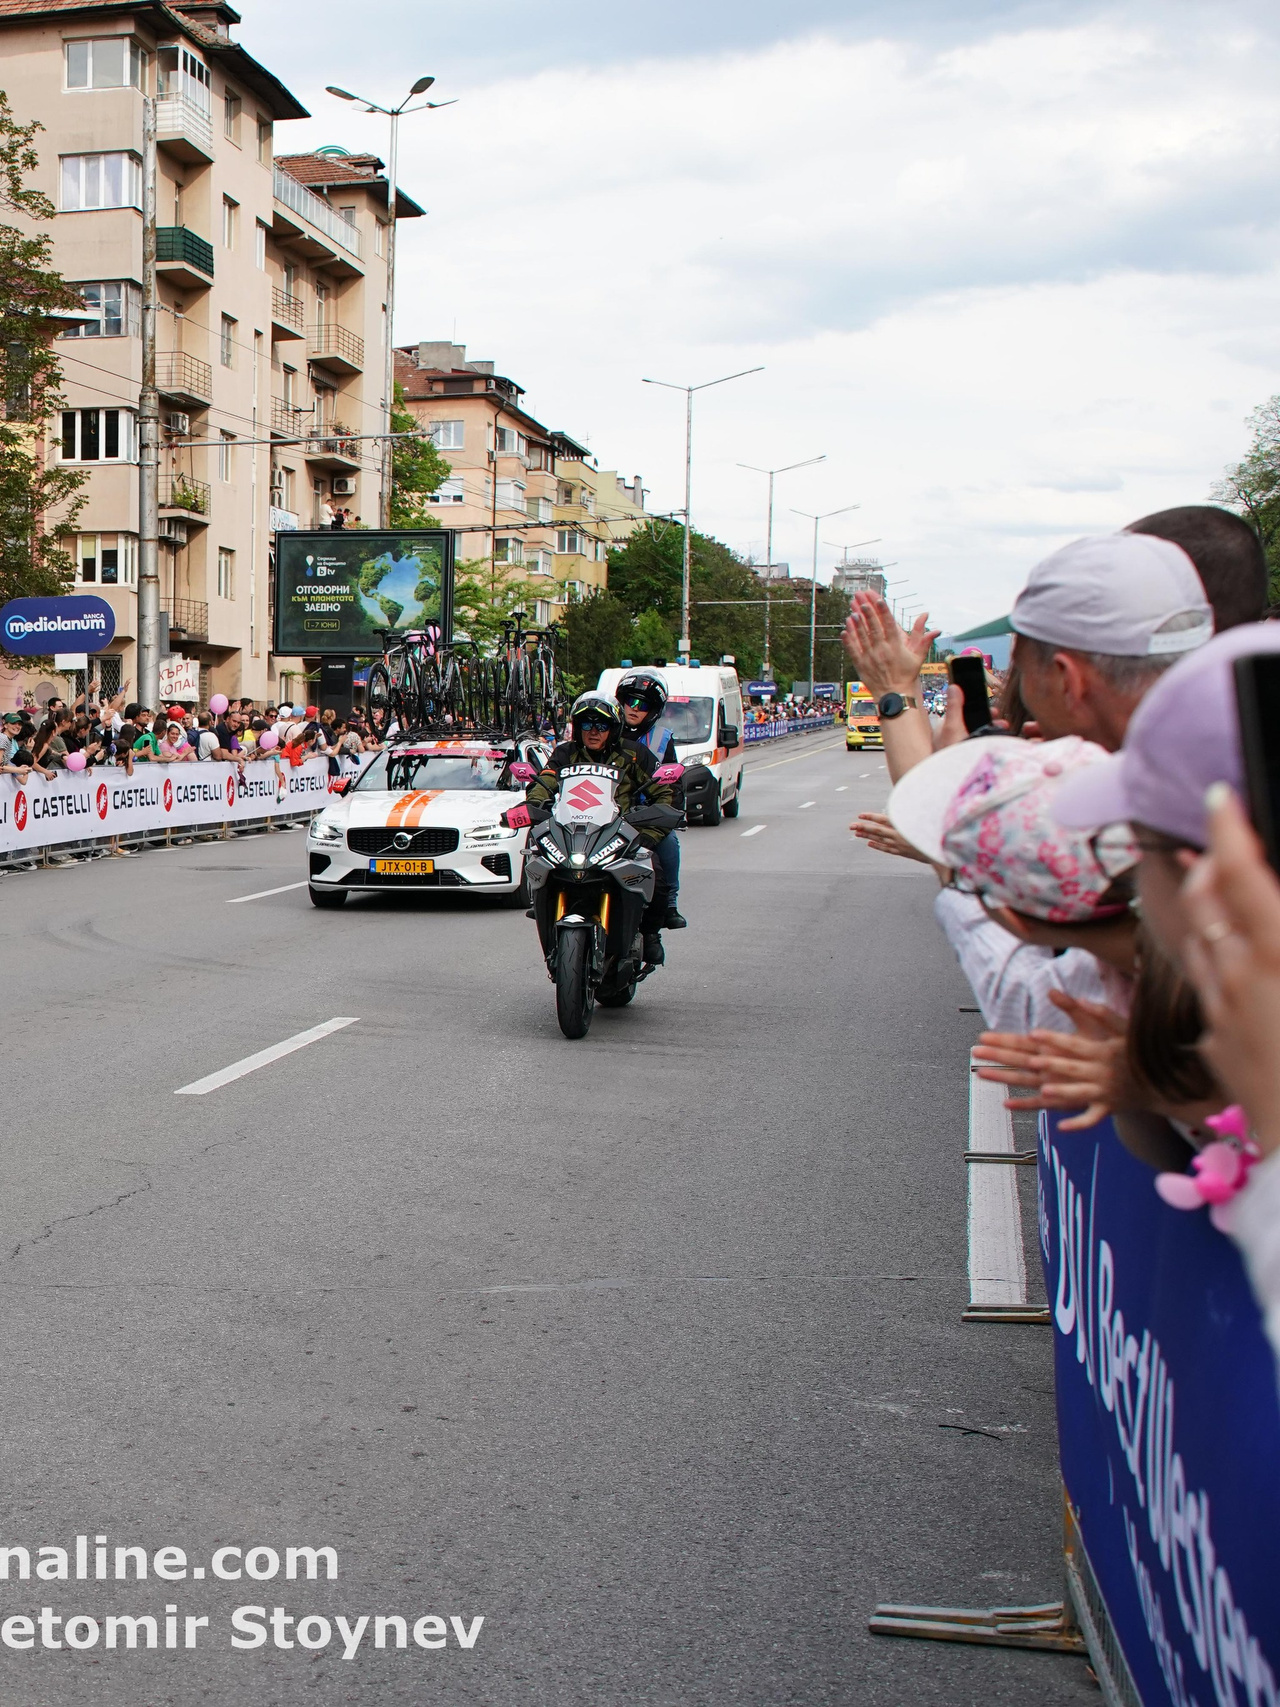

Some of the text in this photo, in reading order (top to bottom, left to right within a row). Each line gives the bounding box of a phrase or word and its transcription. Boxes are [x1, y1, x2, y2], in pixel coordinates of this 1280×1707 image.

[296, 585, 350, 594] ОТГОВОРНИ
[310, 594, 354, 602] планетата
[304, 603, 341, 612] ЗАЕДНО
[10, 616, 106, 633] mediolanum
[560, 764, 618, 780] SUZUKI
[176, 784, 222, 802] CASTELLI
[290, 775, 325, 794] CASTELLI
[33, 794, 90, 819] CASTELLI
[113, 787, 158, 810] CASTELLI
[512, 816, 528, 826] 161
[540, 836, 566, 862] SUZUKI
[590, 838, 624, 865] SUZUKI
[382, 861, 428, 872] JTX-01-B
